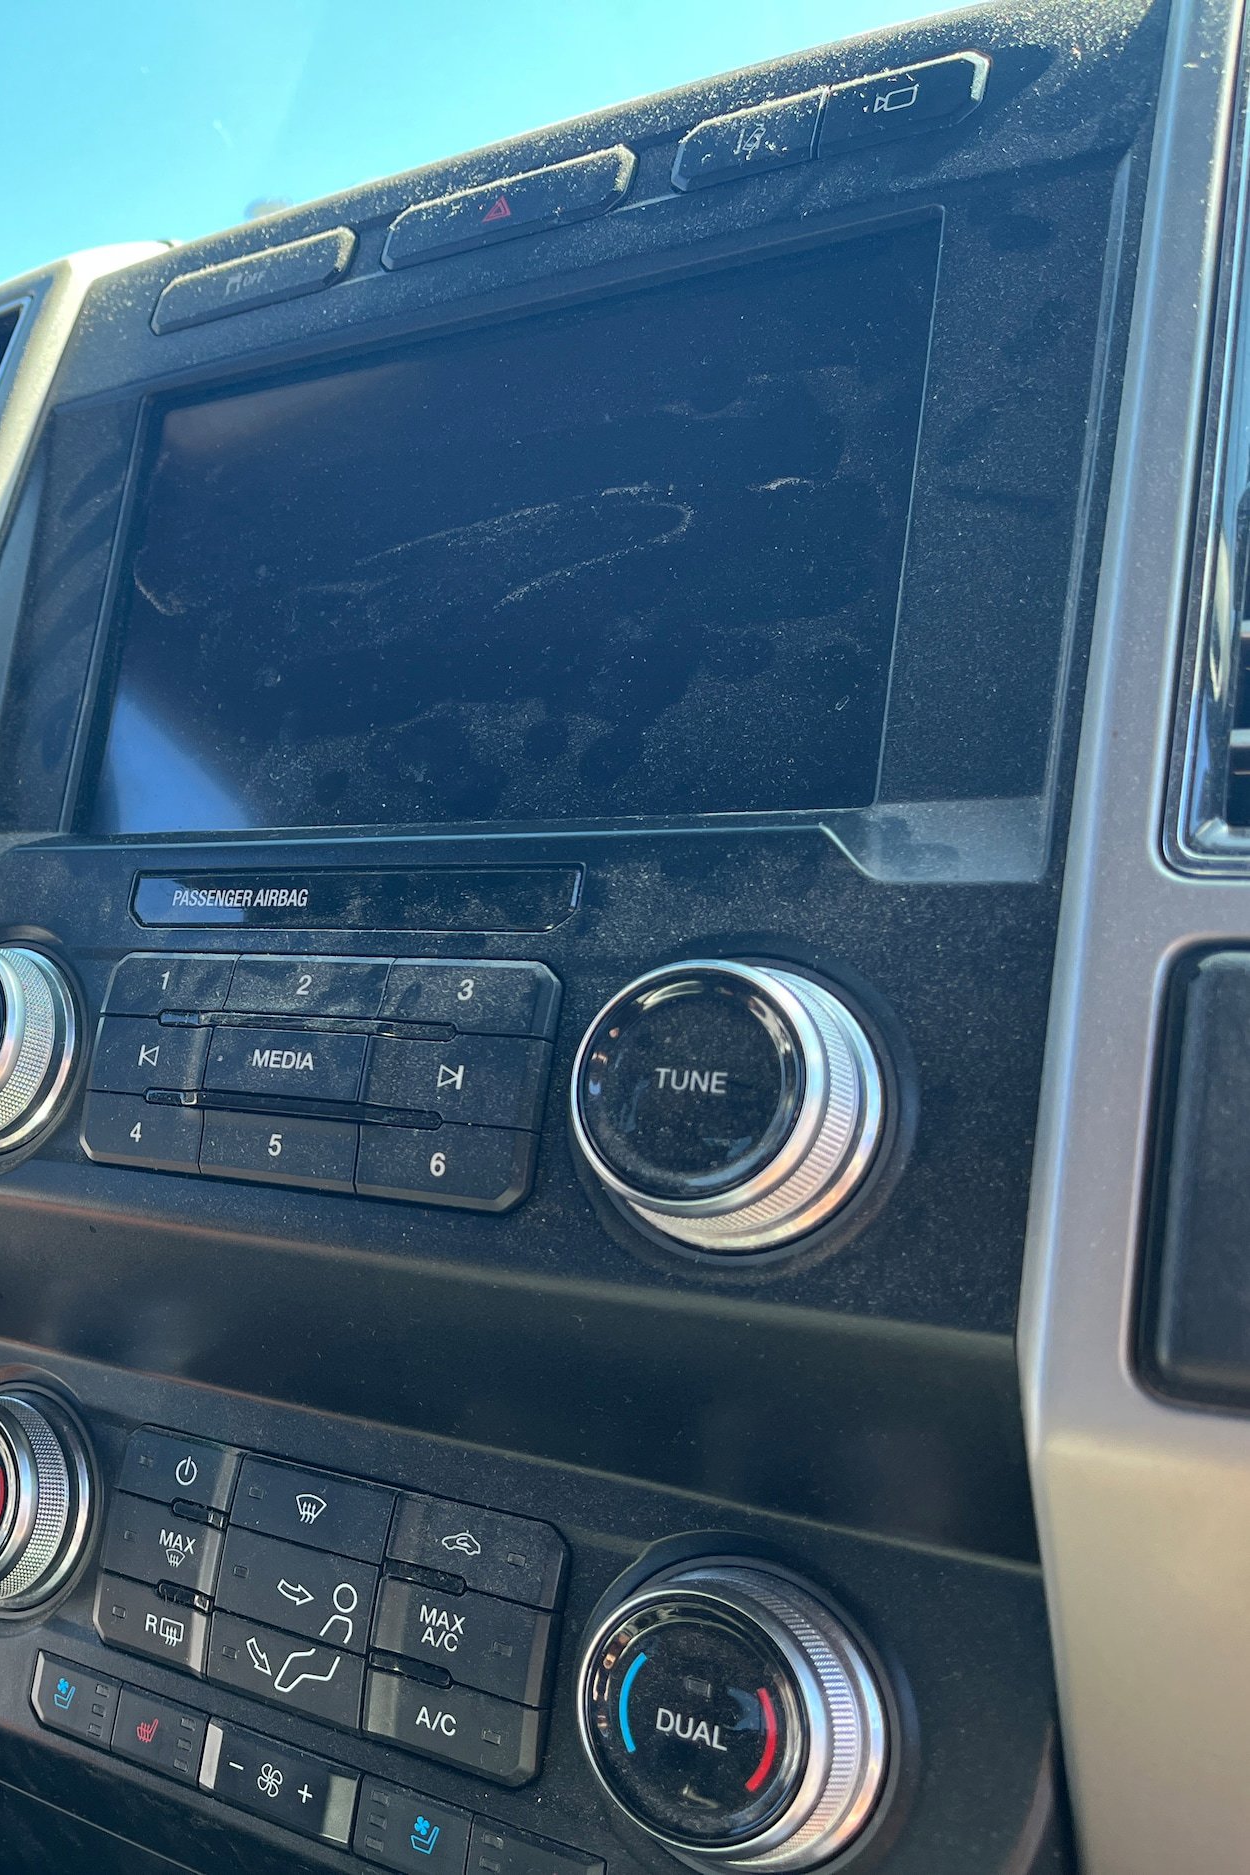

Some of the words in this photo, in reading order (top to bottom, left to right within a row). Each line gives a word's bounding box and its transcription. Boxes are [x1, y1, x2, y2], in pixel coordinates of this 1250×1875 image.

[172, 889, 253, 907] PASSENGER
[253, 888, 309, 907] AIRBAG
[160, 971, 170, 990] 1
[297, 975, 312, 995] 2
[457, 979, 474, 1000] 3
[252, 1049, 314, 1071] MEDIA
[655, 1067, 729, 1094] TUNE
[130, 1122, 142, 1142] 4
[268, 1134, 282, 1156] 5
[429, 1152, 446, 1177] 6
[159, 1528, 196, 1555] MAX
[145, 1614, 157, 1634] R
[419, 1604, 466, 1634] MAX
[421, 1626, 458, 1653] A/C
[415, 1706, 457, 1736] A/C
[656, 1708, 728, 1752] DUAL
